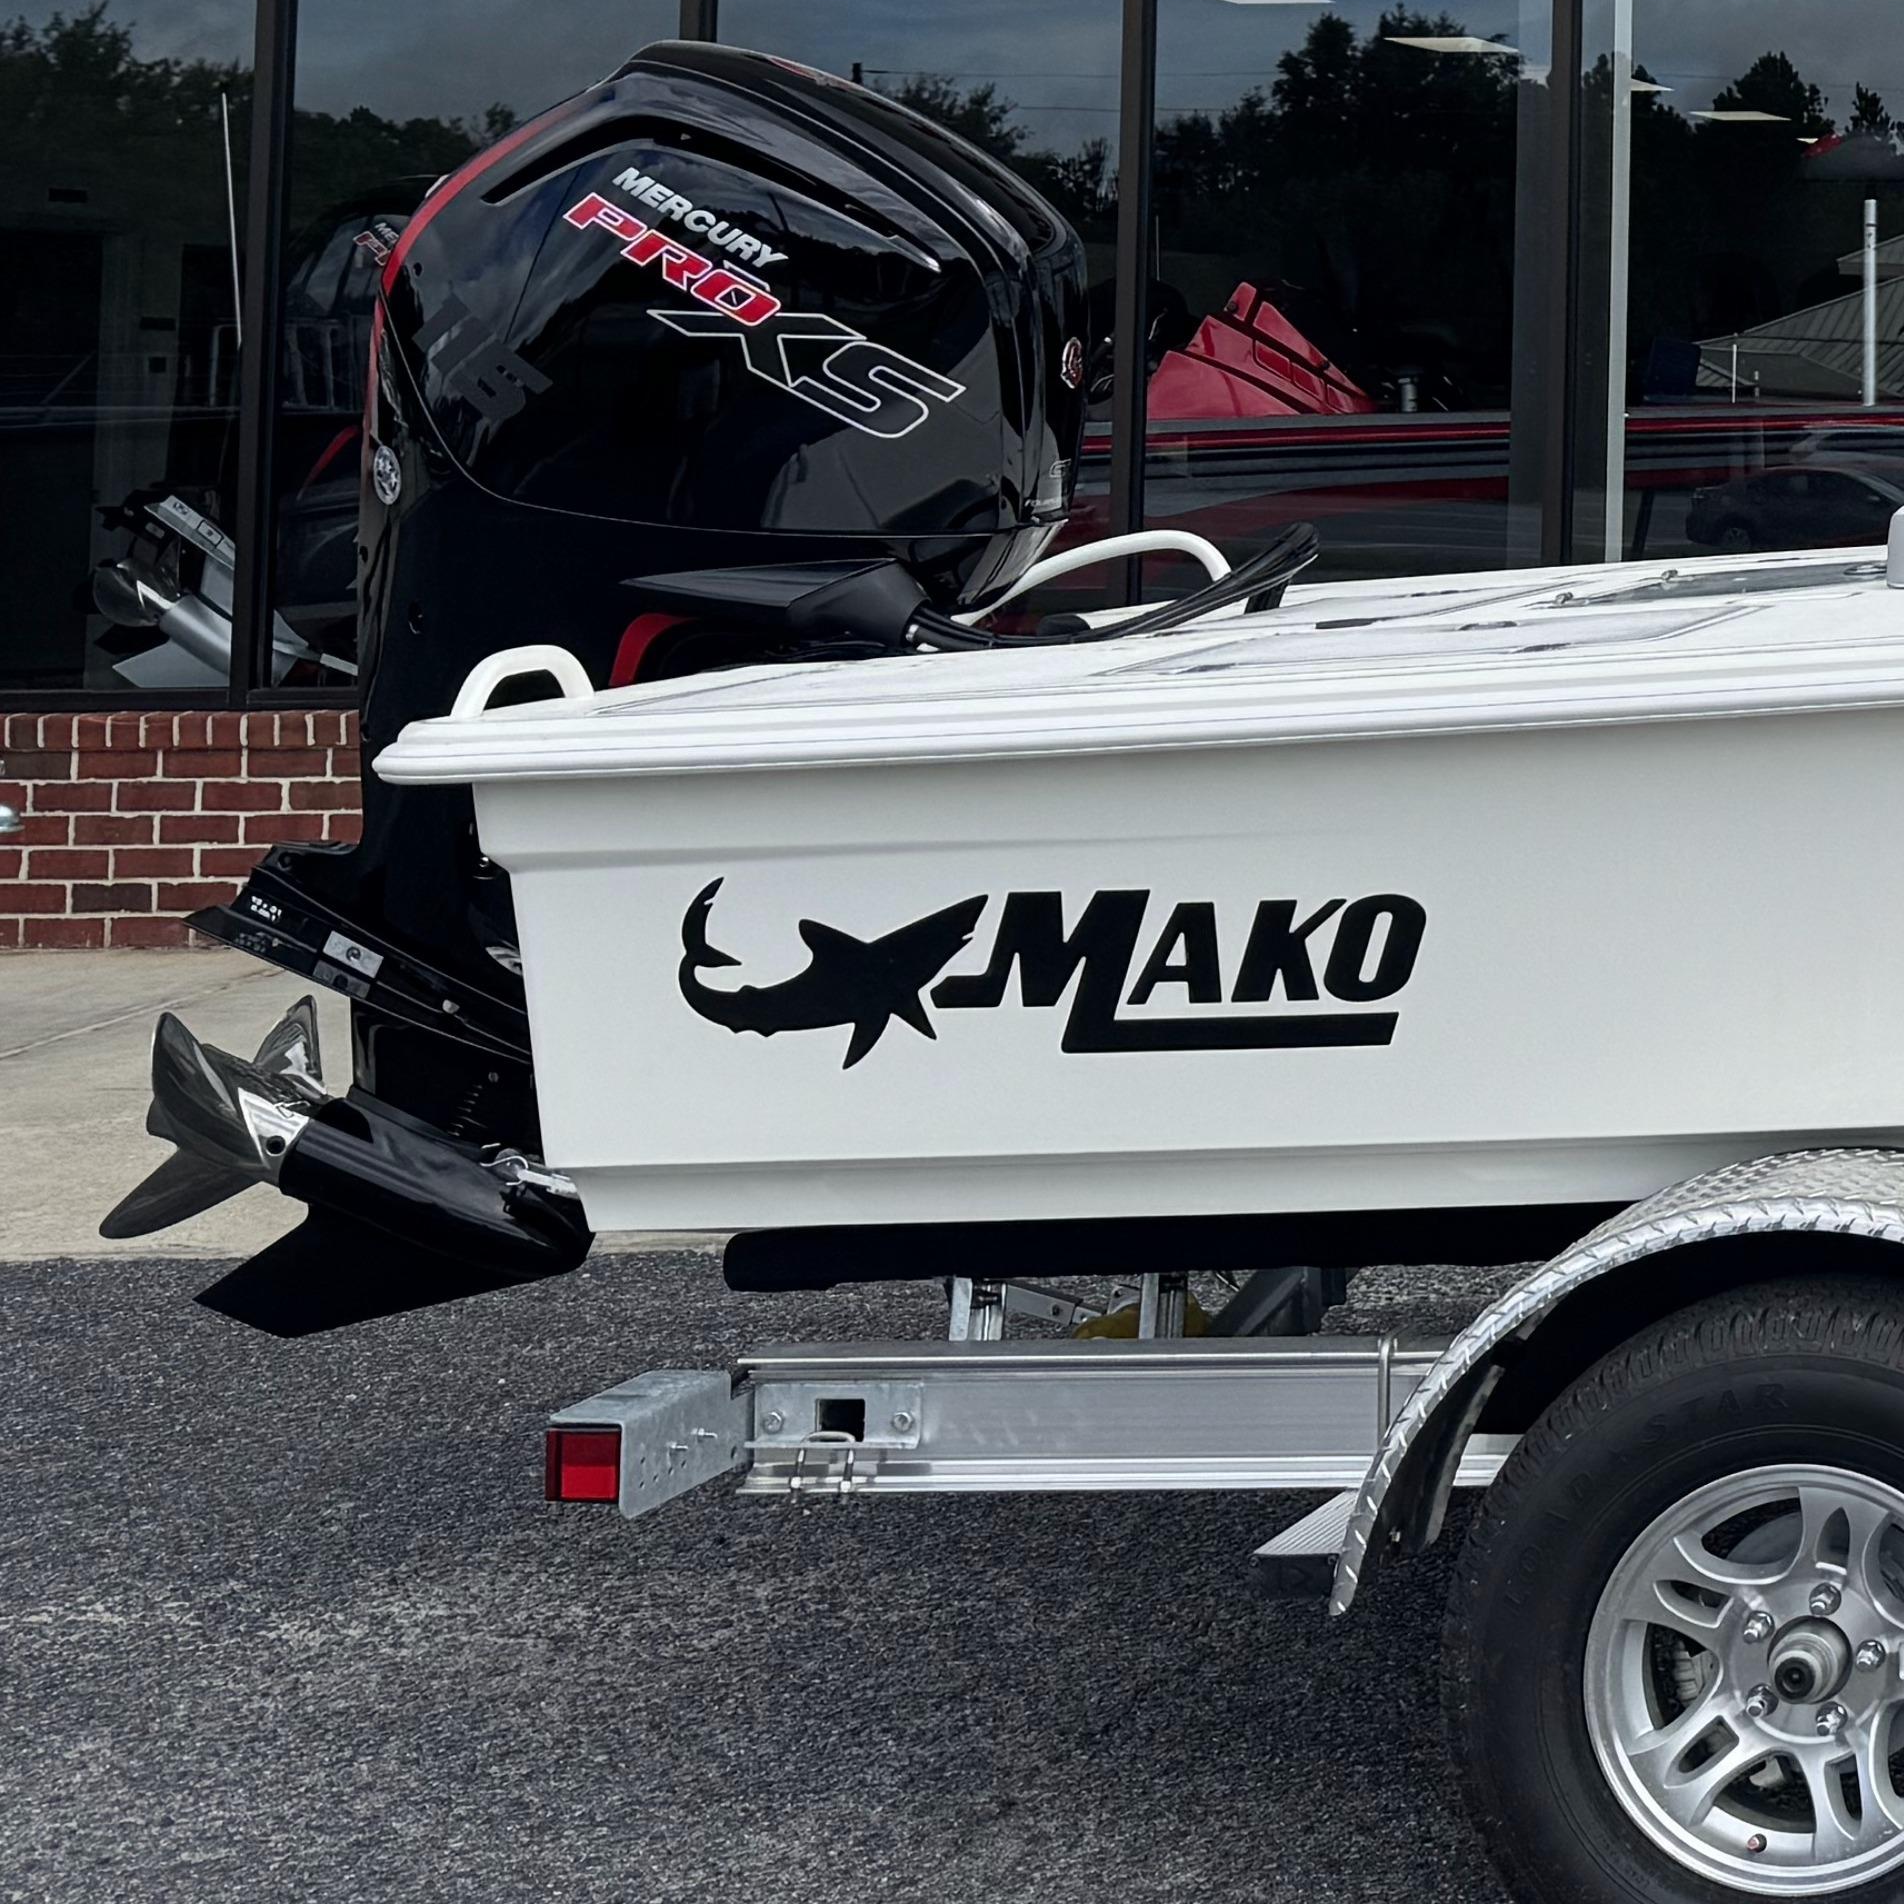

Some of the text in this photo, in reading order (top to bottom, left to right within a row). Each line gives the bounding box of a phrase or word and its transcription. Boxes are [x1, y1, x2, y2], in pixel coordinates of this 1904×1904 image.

[612, 166, 789, 269] MERCURY
[563, 191, 967, 439] PRO XS
[932, 889, 1428, 1053] MAKO
